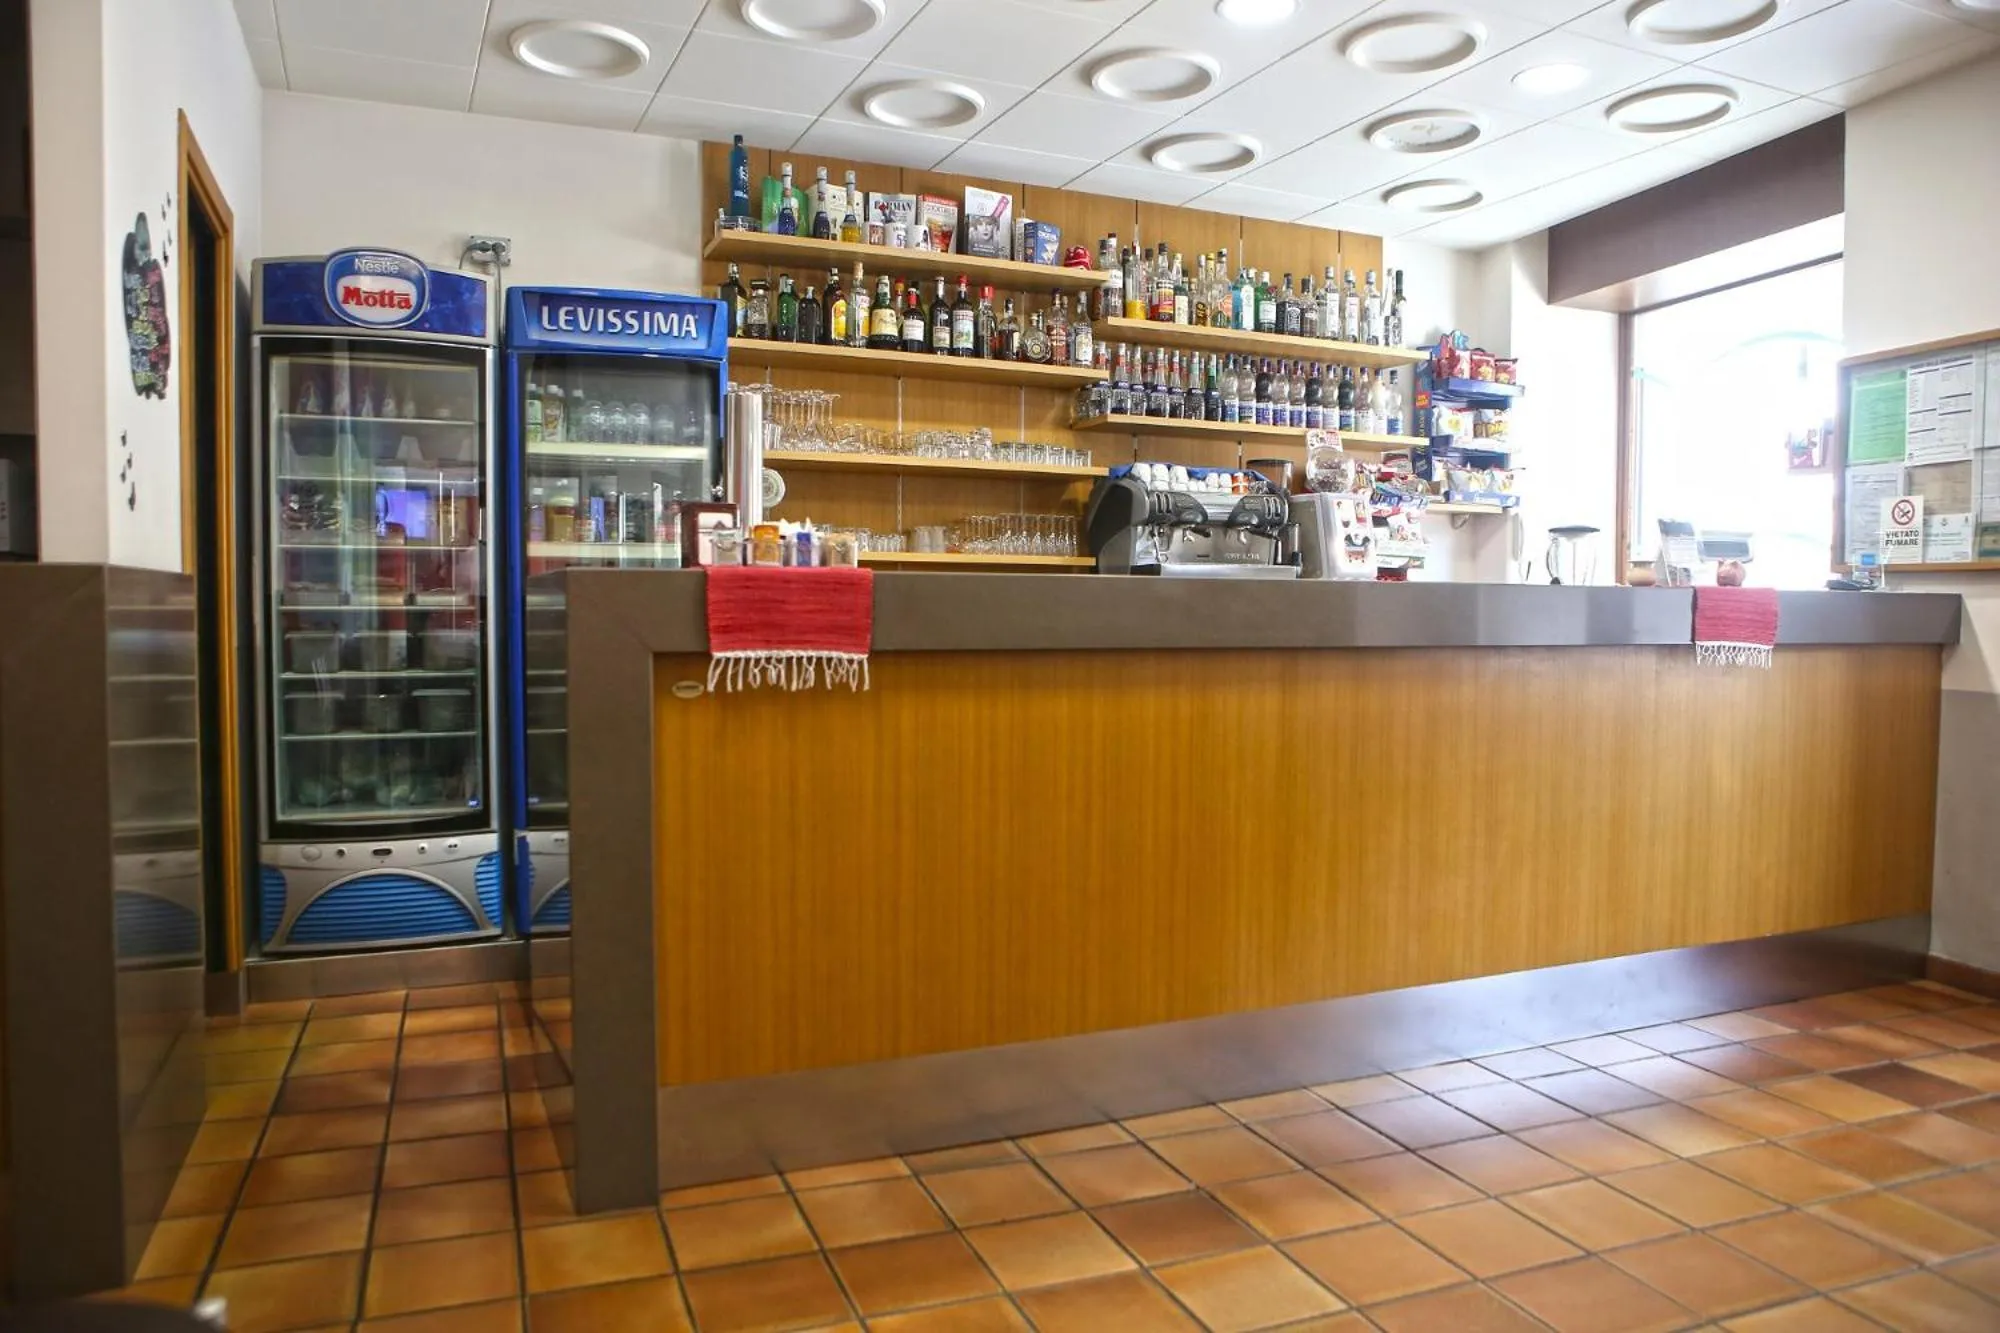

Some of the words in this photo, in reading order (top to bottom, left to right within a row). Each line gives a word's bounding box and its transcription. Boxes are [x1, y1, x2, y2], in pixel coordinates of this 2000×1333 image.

[342, 286, 412, 310] Motta
[541, 304, 698, 339] LEVISSIMA
[1886, 530, 1919, 538] VIETATO
